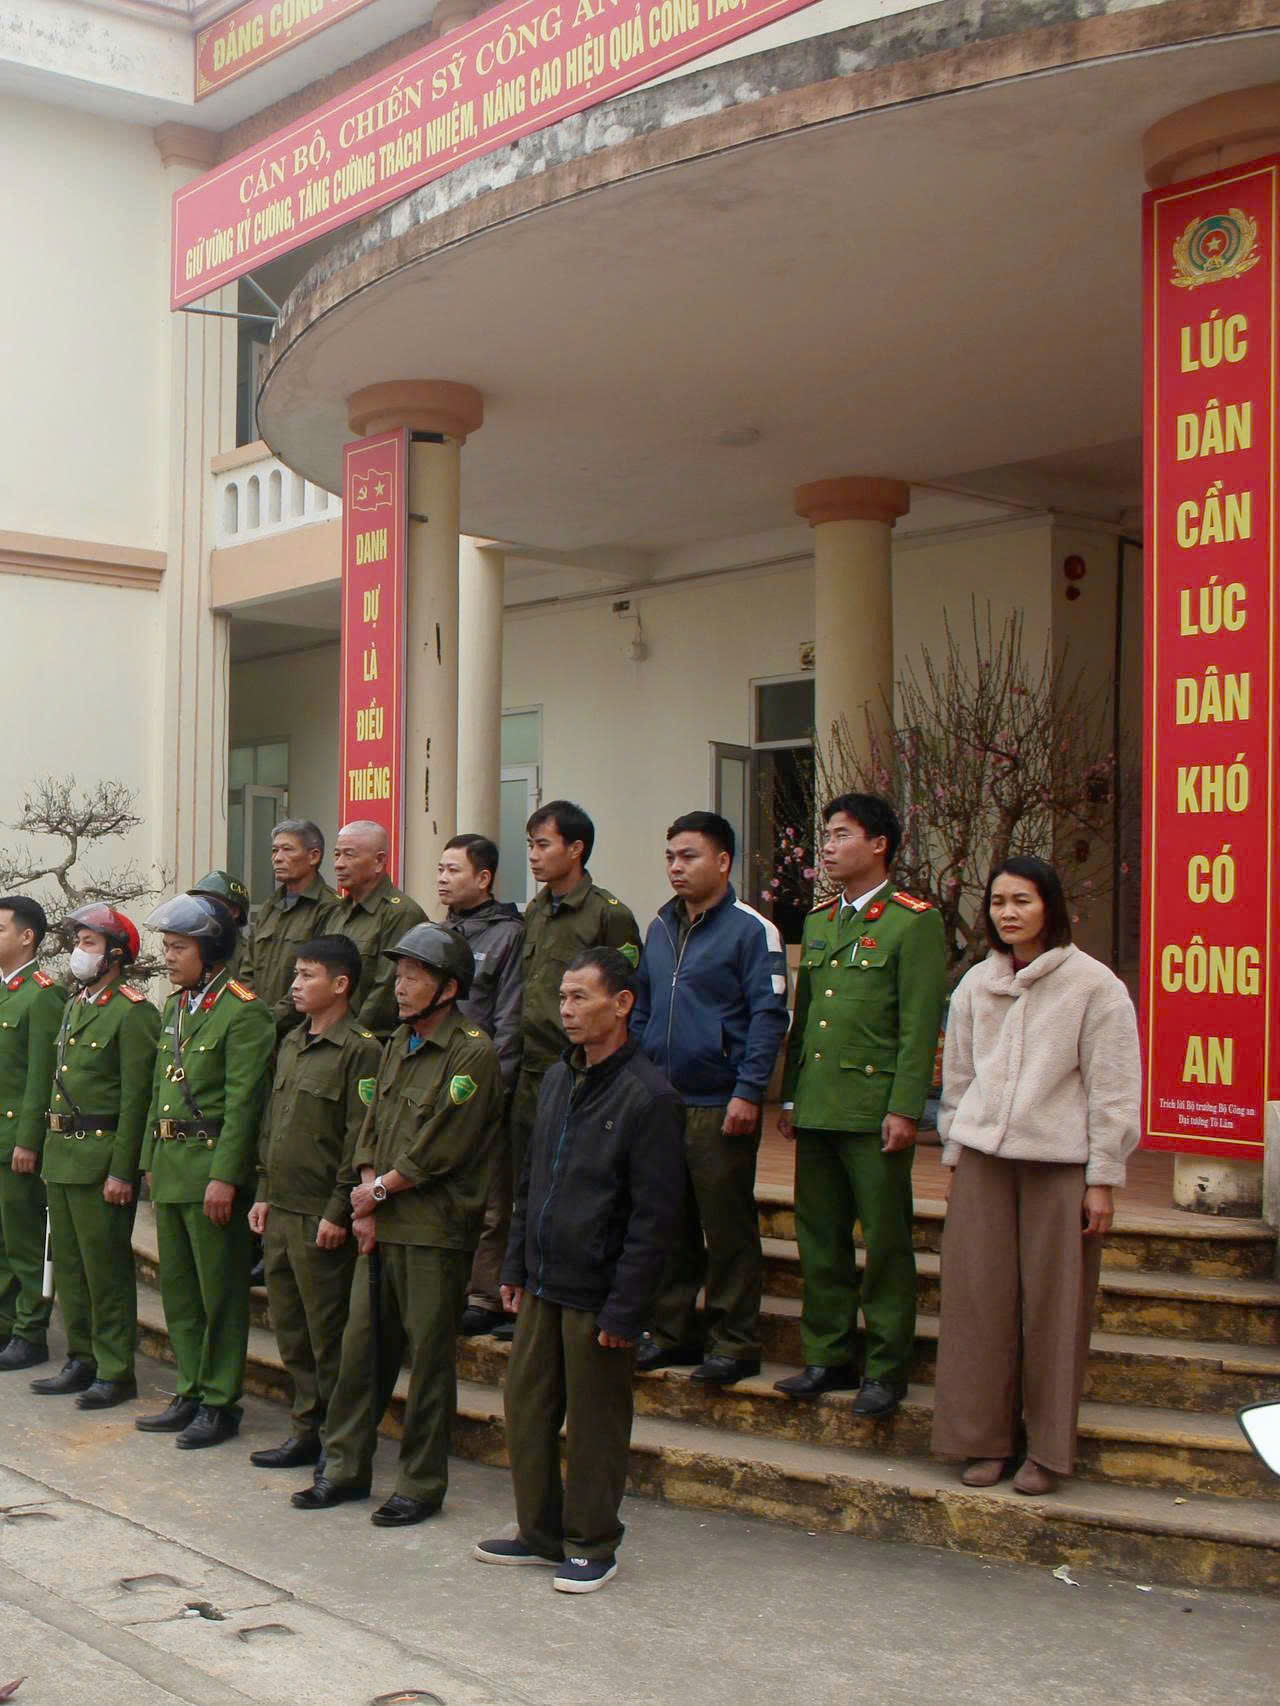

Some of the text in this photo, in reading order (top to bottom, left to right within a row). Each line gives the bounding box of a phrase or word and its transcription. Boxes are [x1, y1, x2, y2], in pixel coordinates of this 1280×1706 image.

[213, 19, 264, 71] ĐẢNG
[240, 156, 287, 204] CÁN
[293, 129, 331, 176] BỘ,
[339, 76, 423, 148] CHIẾN
[432, 50, 467, 100] SỸ
[476, 5, 563, 75] CÔNG
[185, 236, 205, 280] GIỮ
[205, 227, 234, 270] VỮNG
[236, 208, 252, 254] KỶ
[254, 196, 295, 246] CƯƠNG,
[298, 175, 330, 222] TĂNG
[333, 152, 376, 204] CƯỜNG
[379, 128, 422, 180] TRÁCH
[426, 100, 478, 157] NHIỆM,
[483, 78, 526, 129] NÂNG
[530, 57, 562, 107] CAO
[566, 33, 605, 89] HIỆU
[609, 4, 644, 70] QUẢ
[1180, 309, 1248, 373] LÚC
[1176, 398, 1252, 462] DÂN
[1176, 480, 1251, 549] CẦN
[356, 528, 388, 566] DANH
[363, 584, 381, 629] DỰ
[1179, 575, 1247, 637] LÚC
[363, 641, 379, 682] LÀ
[356, 697, 385, 742] ĐIỀU
[1175, 665, 1251, 726] DÂN
[349, 761, 390, 801] THIÊNG
[1176, 753, 1250, 814] KHÓ
[1187, 844, 1236, 904] CÓ
[1160, 936, 1261, 996] CÔNG
[1182, 1036, 1234, 1086] AN
